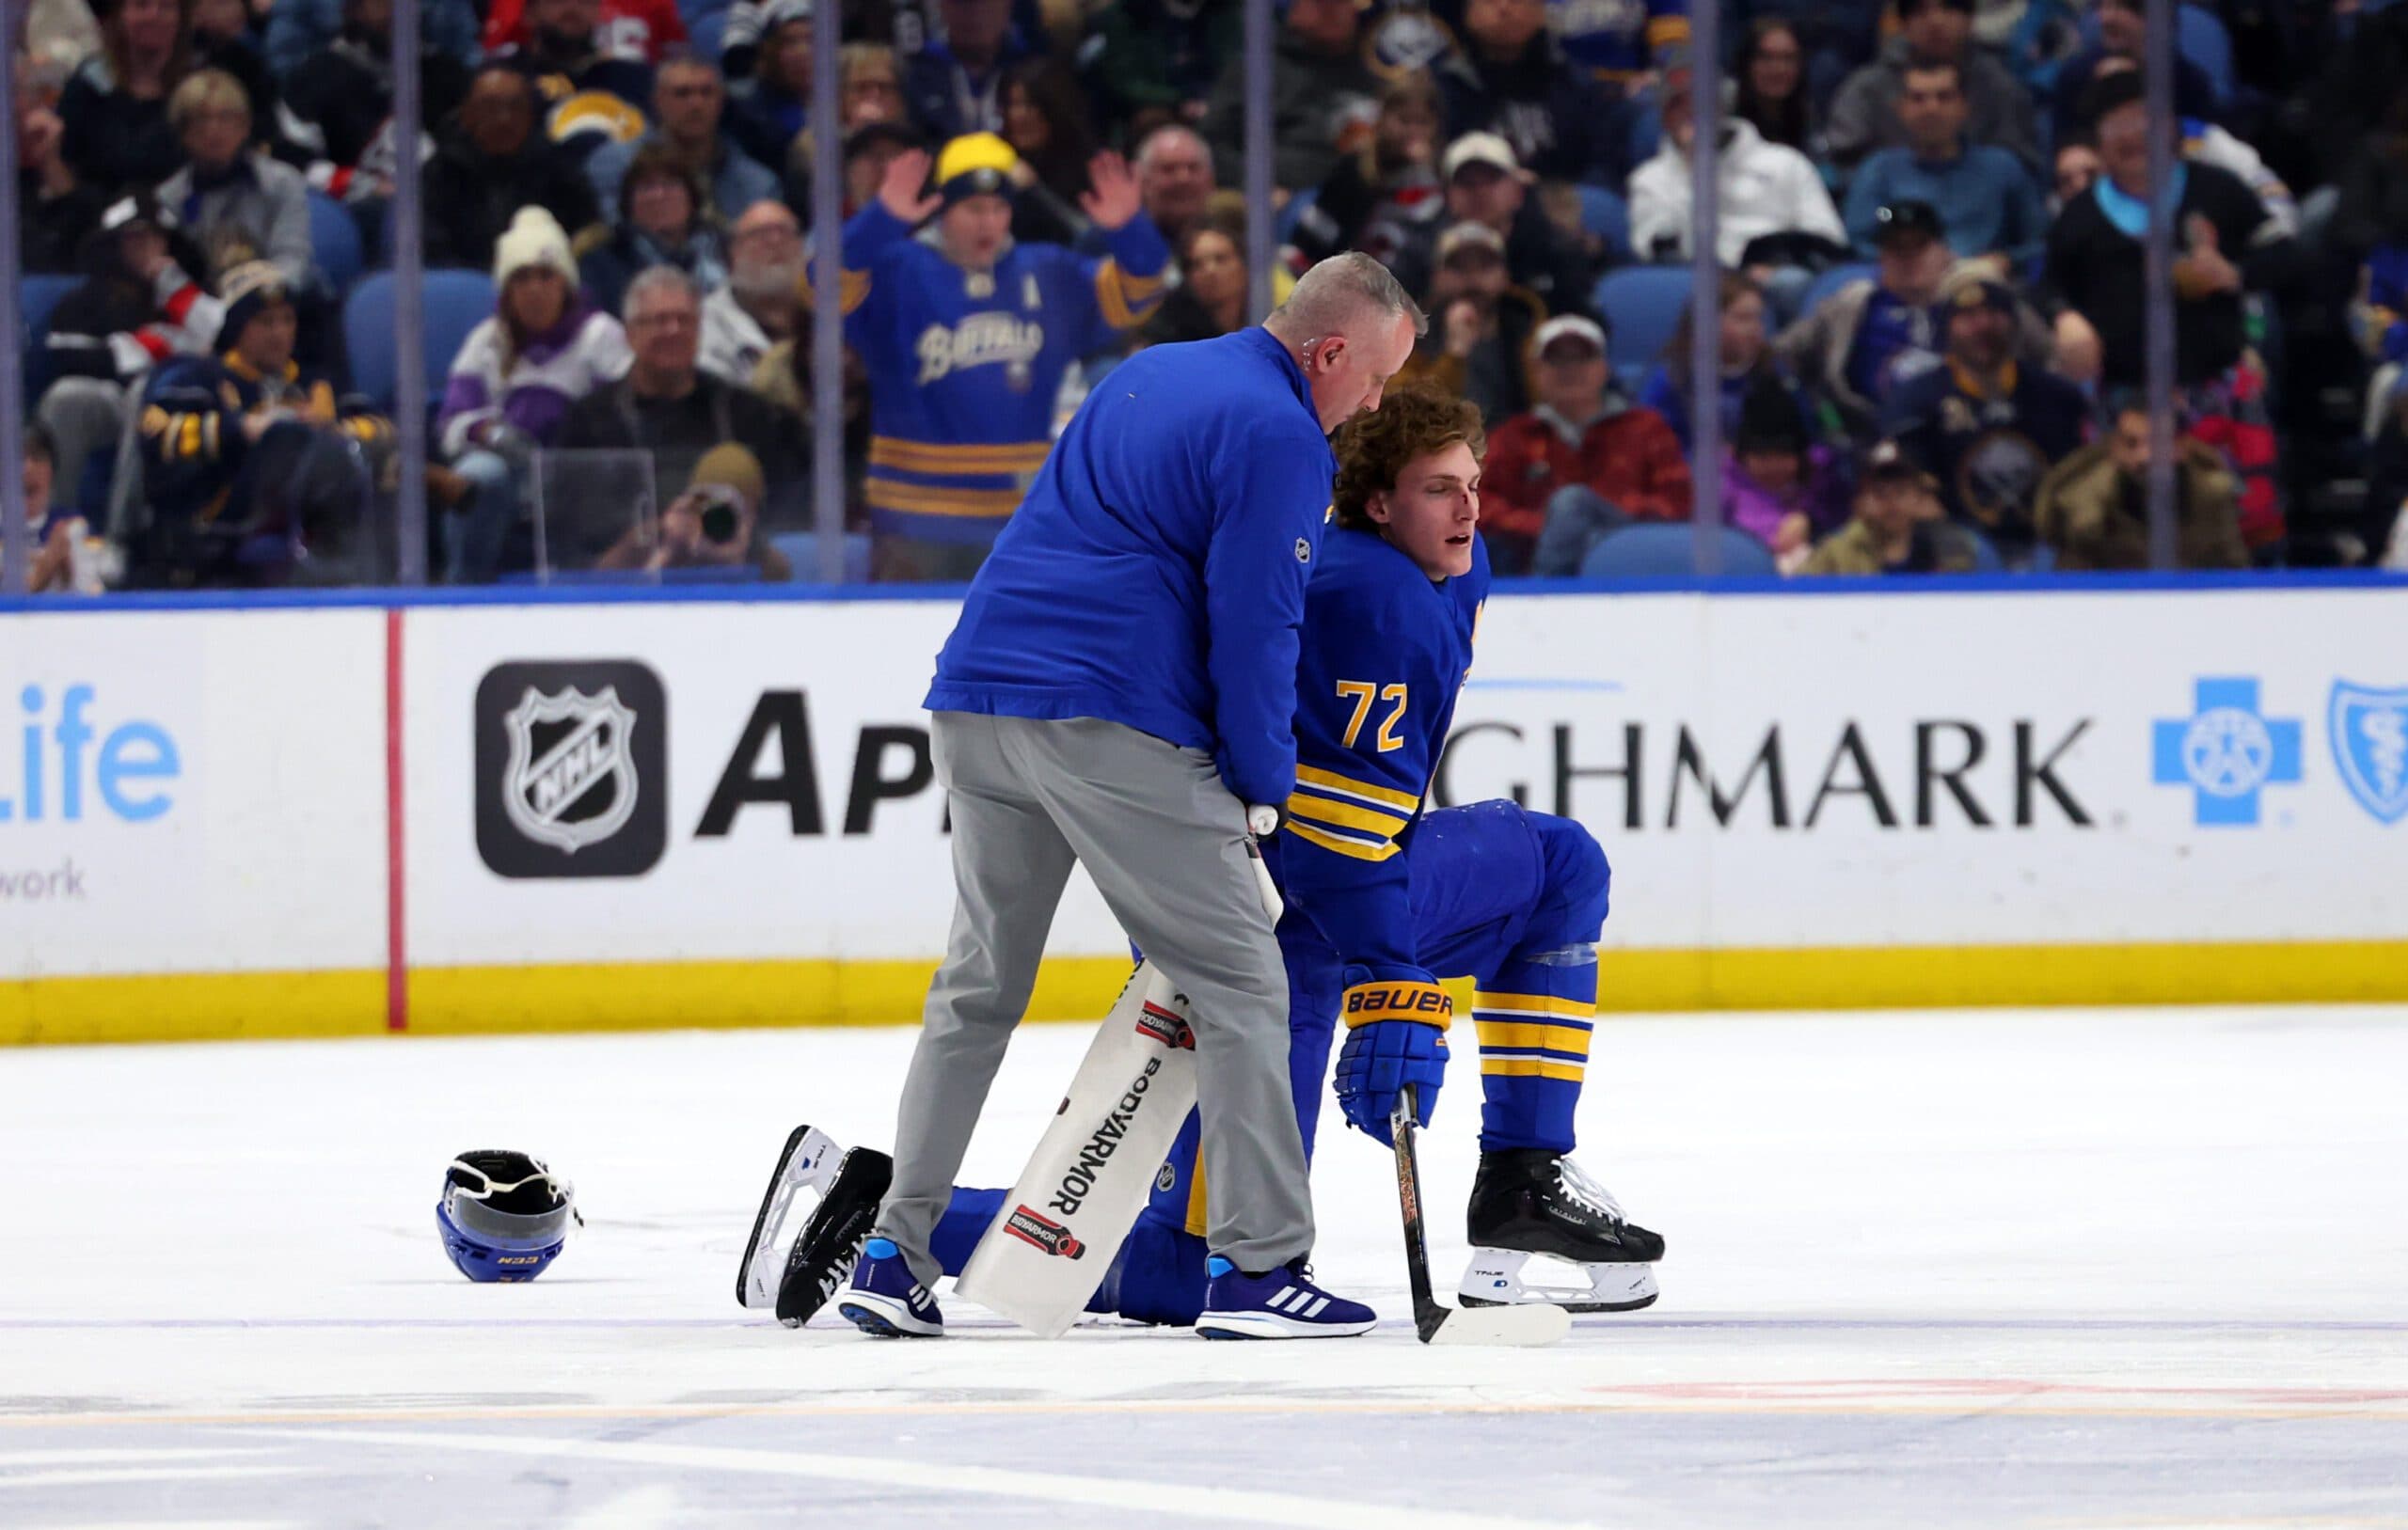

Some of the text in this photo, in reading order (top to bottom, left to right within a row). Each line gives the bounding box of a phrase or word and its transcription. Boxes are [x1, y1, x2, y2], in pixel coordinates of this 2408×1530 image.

[0, 683, 182, 824] ife
[692, 689, 953, 837] AP
[1336, 679, 1408, 752] 72
[1431, 720, 2095, 830] GHMARK
[1347, 988, 1452, 1017] BAUER
[1048, 1056, 1163, 1216] BODYARMOR
